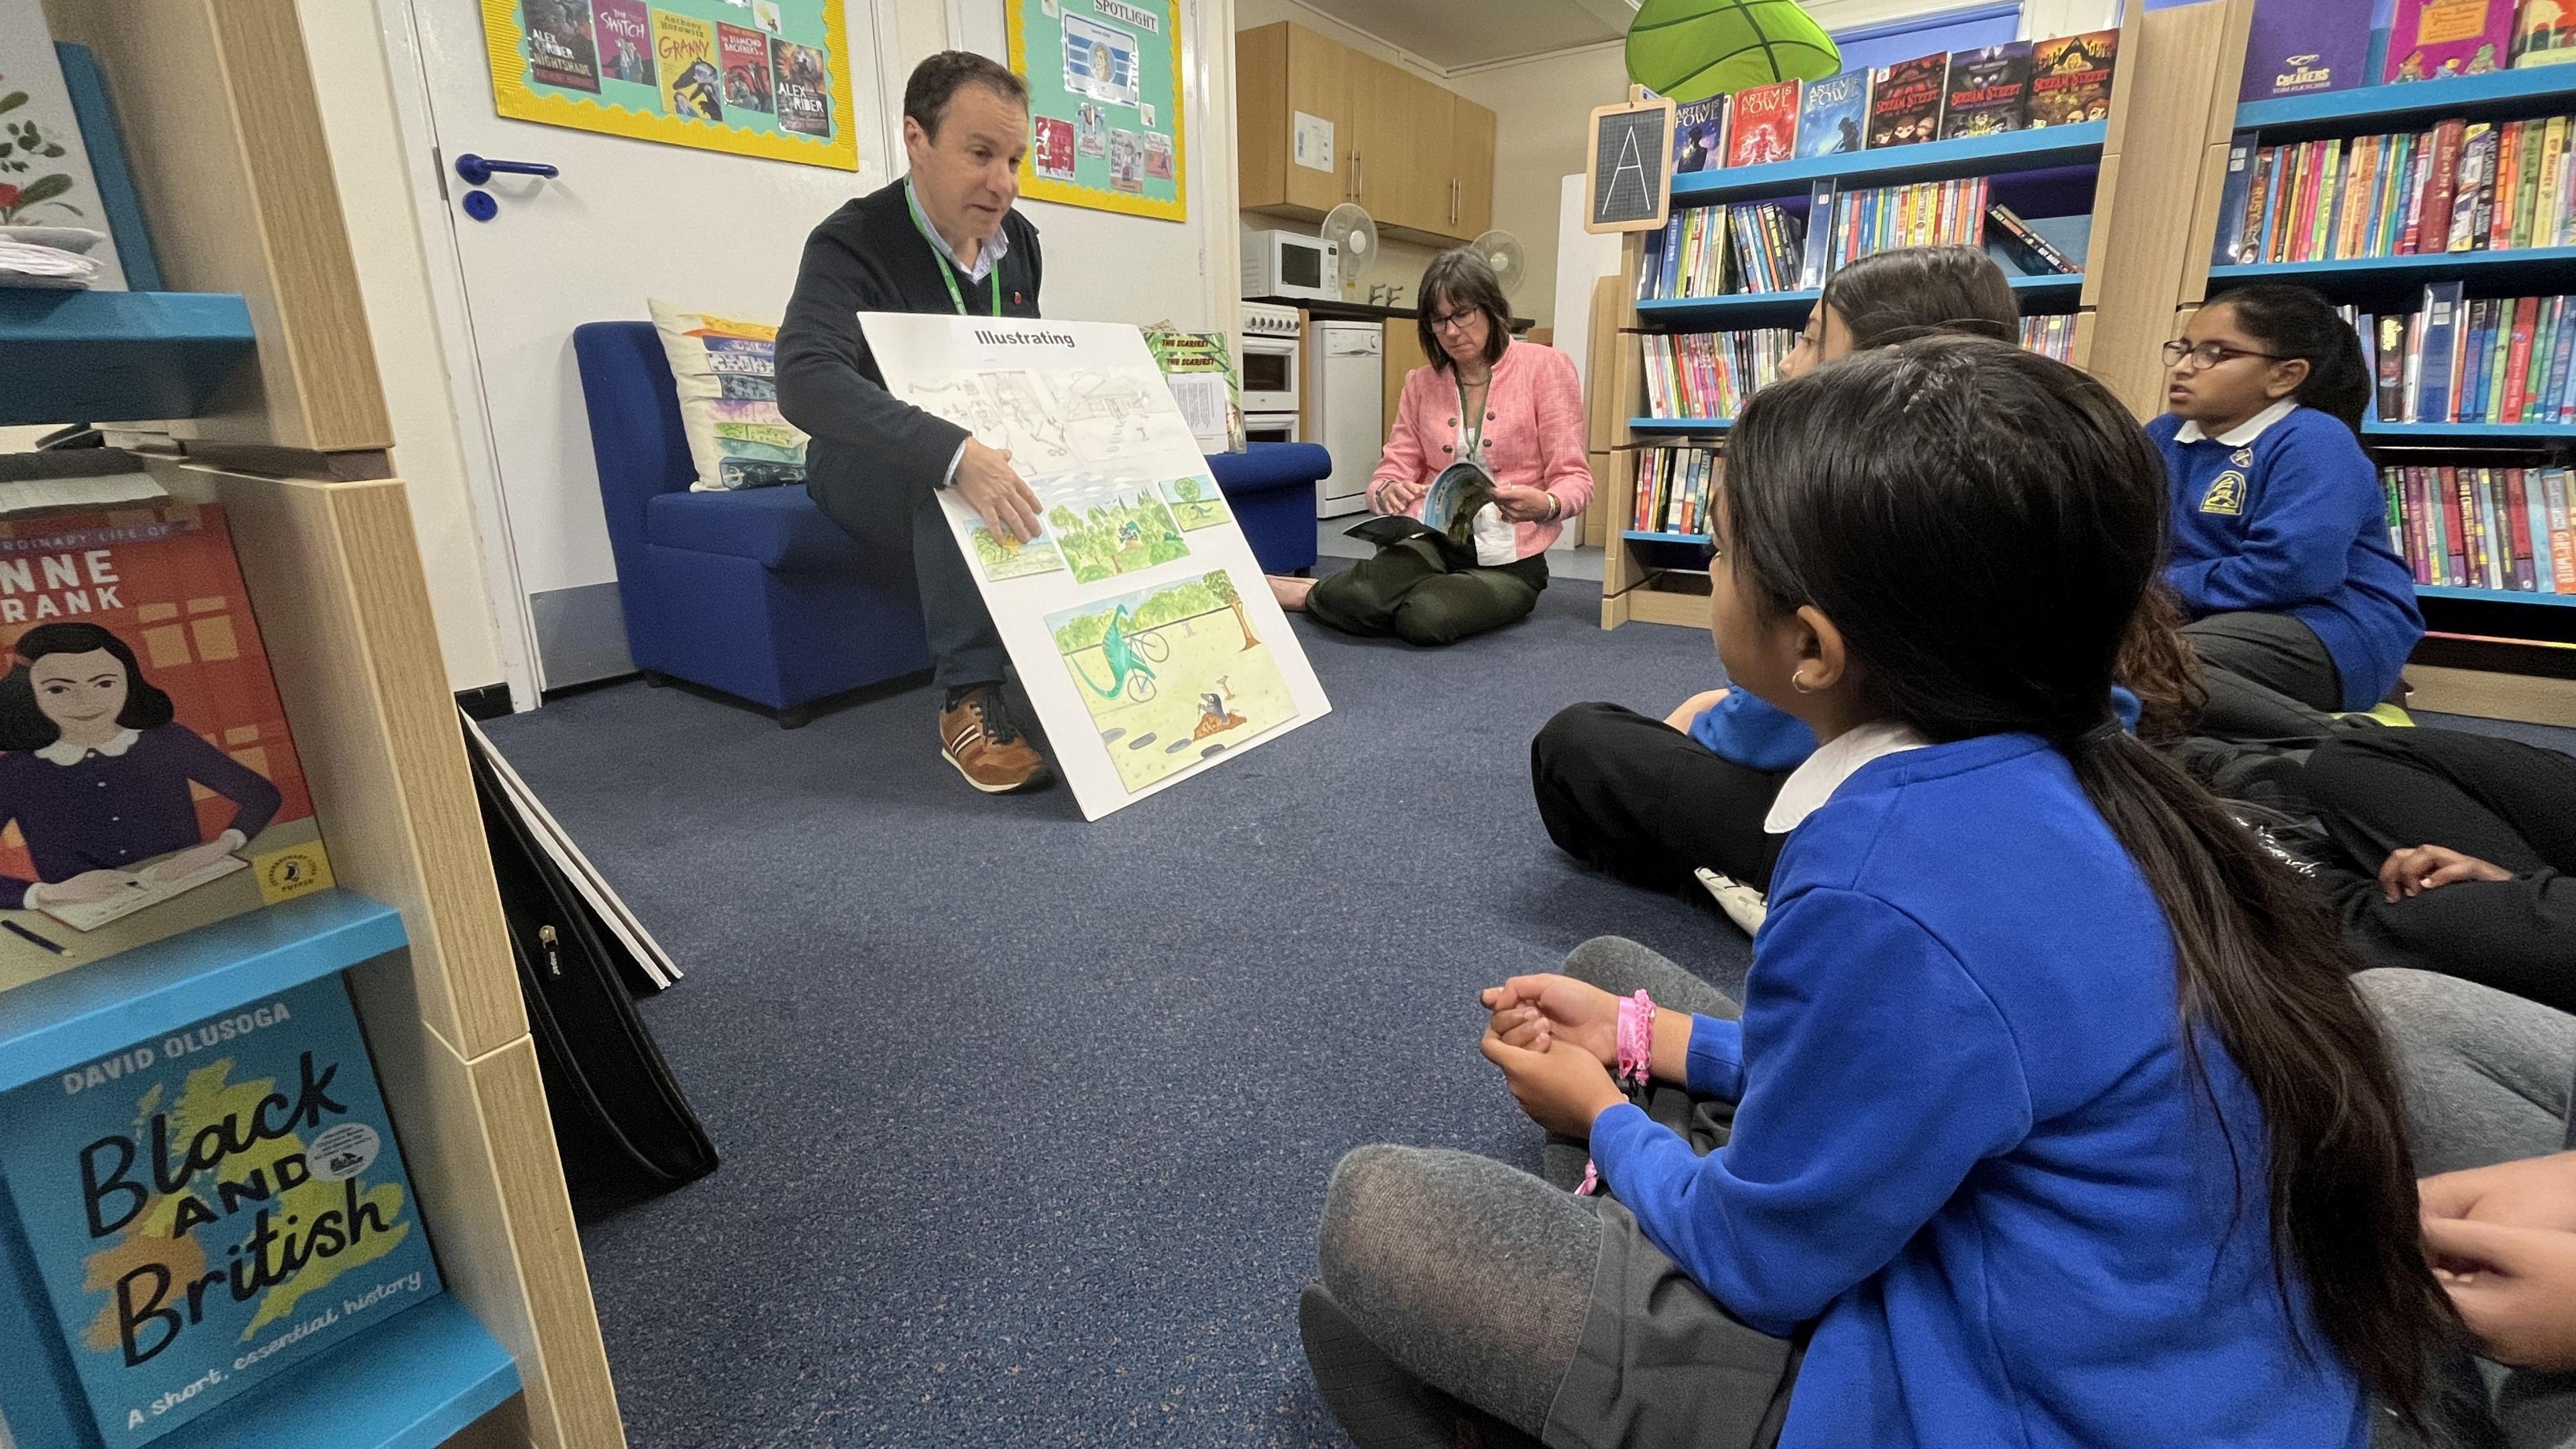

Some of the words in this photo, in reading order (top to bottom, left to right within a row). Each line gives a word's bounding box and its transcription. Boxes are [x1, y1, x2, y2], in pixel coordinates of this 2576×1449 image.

[613, 9, 626, 19] THE
[600, 12, 645, 39] SWITCH
[661, 21, 704, 38] Horowitz
[664, 15, 701, 32] Anthony
[533, 28, 558, 45] ALEX
[729, 36, 762, 48] DIAMOND
[545, 42, 574, 60] RIDER
[659, 36, 709, 60] GRANNY
[725, 43, 758, 56] BROTHERS
[534, 52, 592, 76] NIGHTSHADE
[779, 82, 807, 98] ALEX
[1741, 86, 1792, 106] ARTEMIS
[793, 97, 824, 113] RIDER
[1676, 99, 1719, 119] ARTEMIS
[1741, 96, 1790, 116] FOWL
[1676, 111, 1718, 129] FOWL
[1602, 125, 1651, 215] A
[974, 330, 1075, 348] Illustrating
[1177, 339, 1209, 347] SCARIEST
[1181, 358, 1214, 366] SCARIEST
[100, 531, 137, 541] LIFE
[148, 526, 168, 537] OF
[64, 1048, 153, 1095] DAVID
[165, 1004, 290, 1059] OLUSOGA
[78, 1051, 347, 1238] Black
[172, 1153, 310, 1239] AND
[116, 1178, 389, 1368] British
[127, 1409, 144, 1430] A
[233, 1312, 339, 1370] essential
[343, 1272, 422, 1316] history
